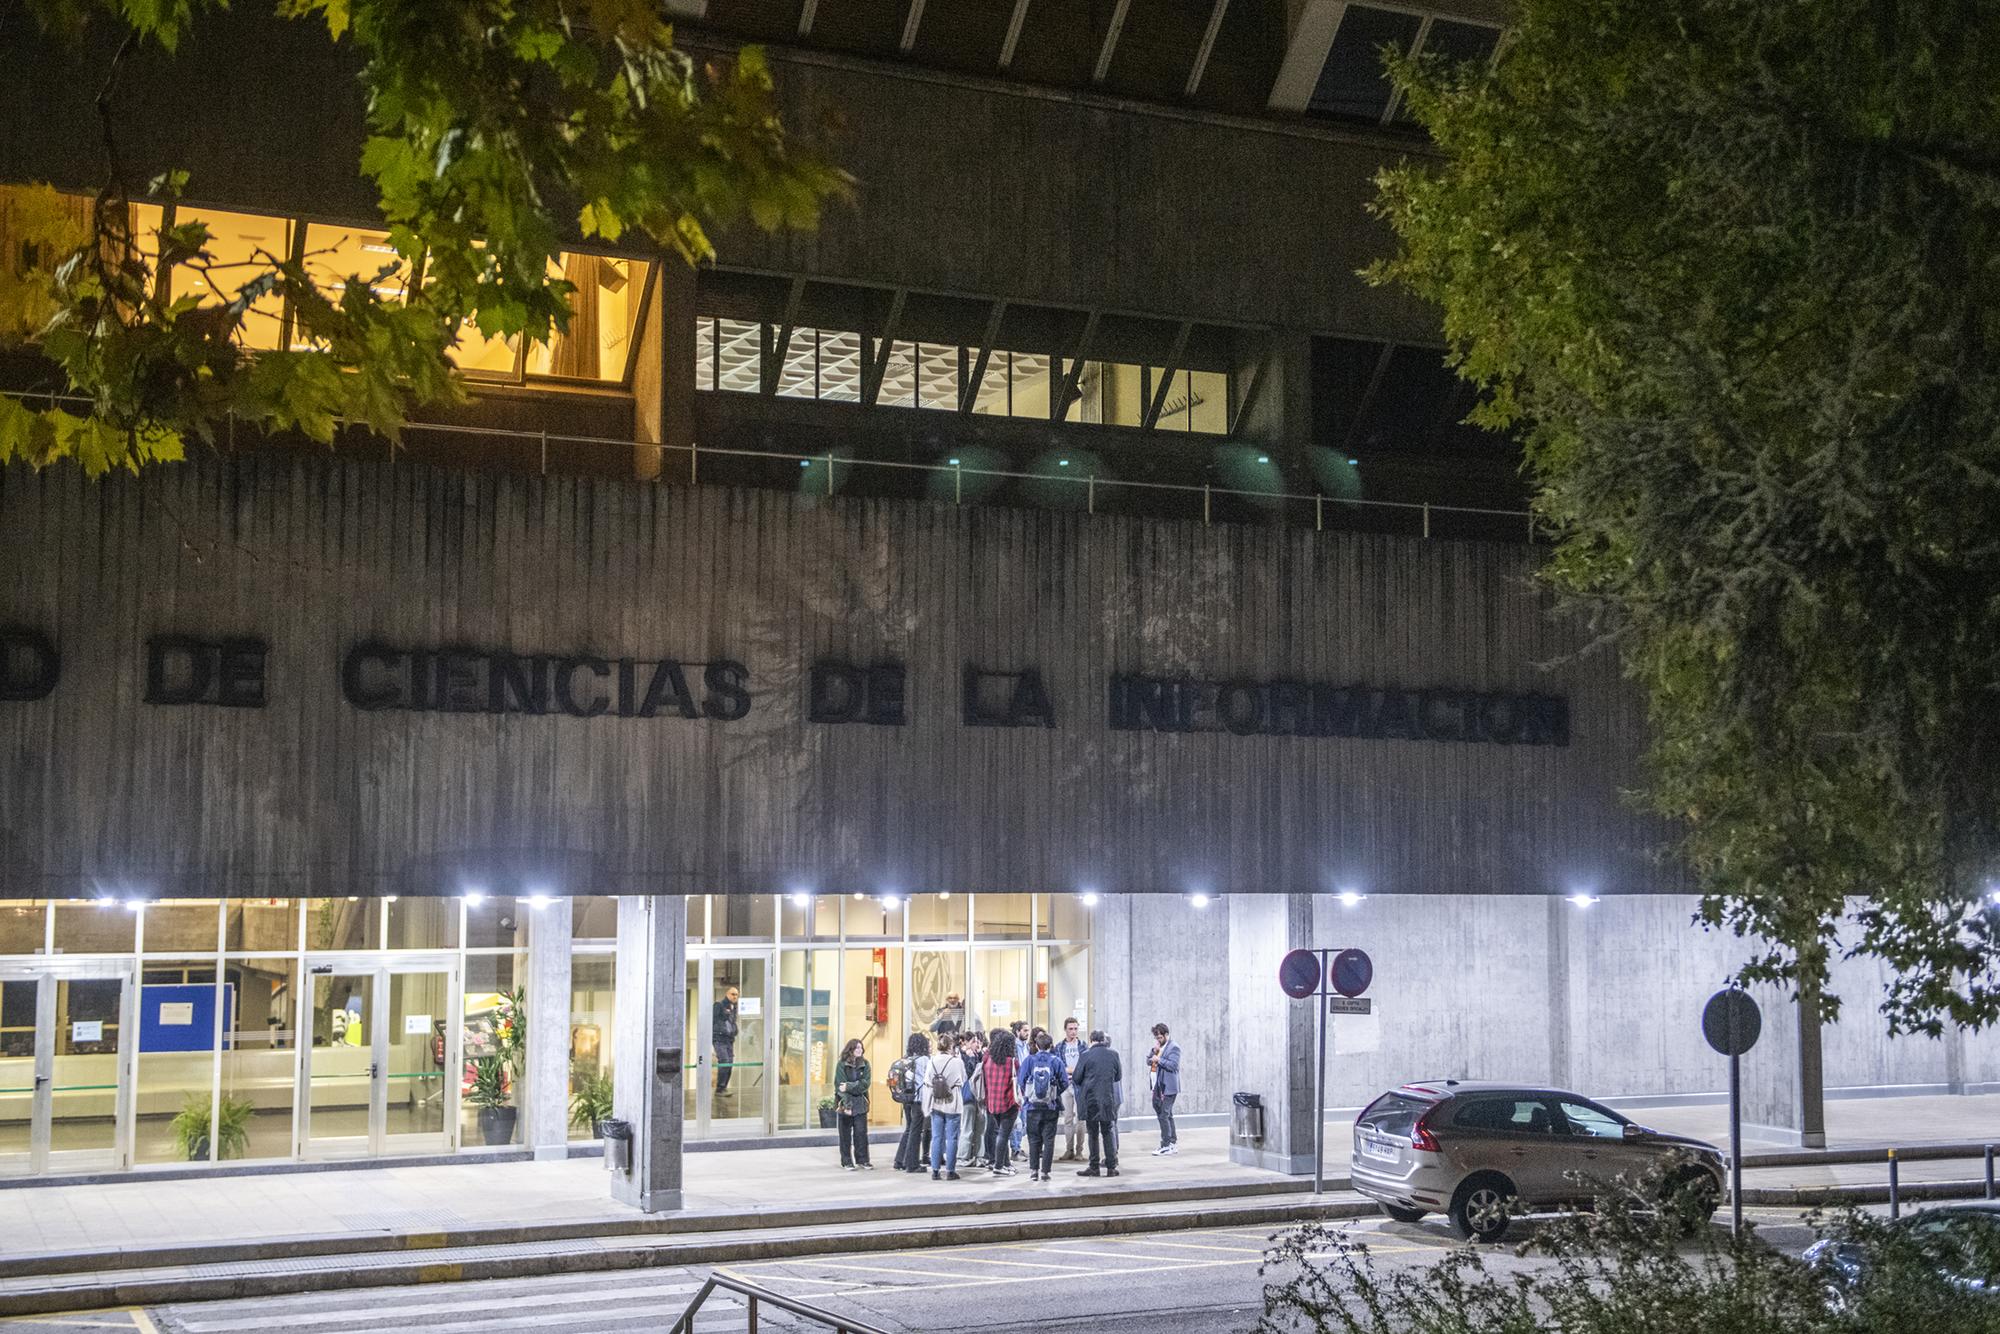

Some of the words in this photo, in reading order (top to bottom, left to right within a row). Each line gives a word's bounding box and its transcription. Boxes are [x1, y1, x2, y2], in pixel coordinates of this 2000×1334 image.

[145, 637, 267, 706] DE
[343, 644, 751, 718] CIENCIAS
[810, 660, 904, 724] DE
[963, 665, 1054, 727] LA
